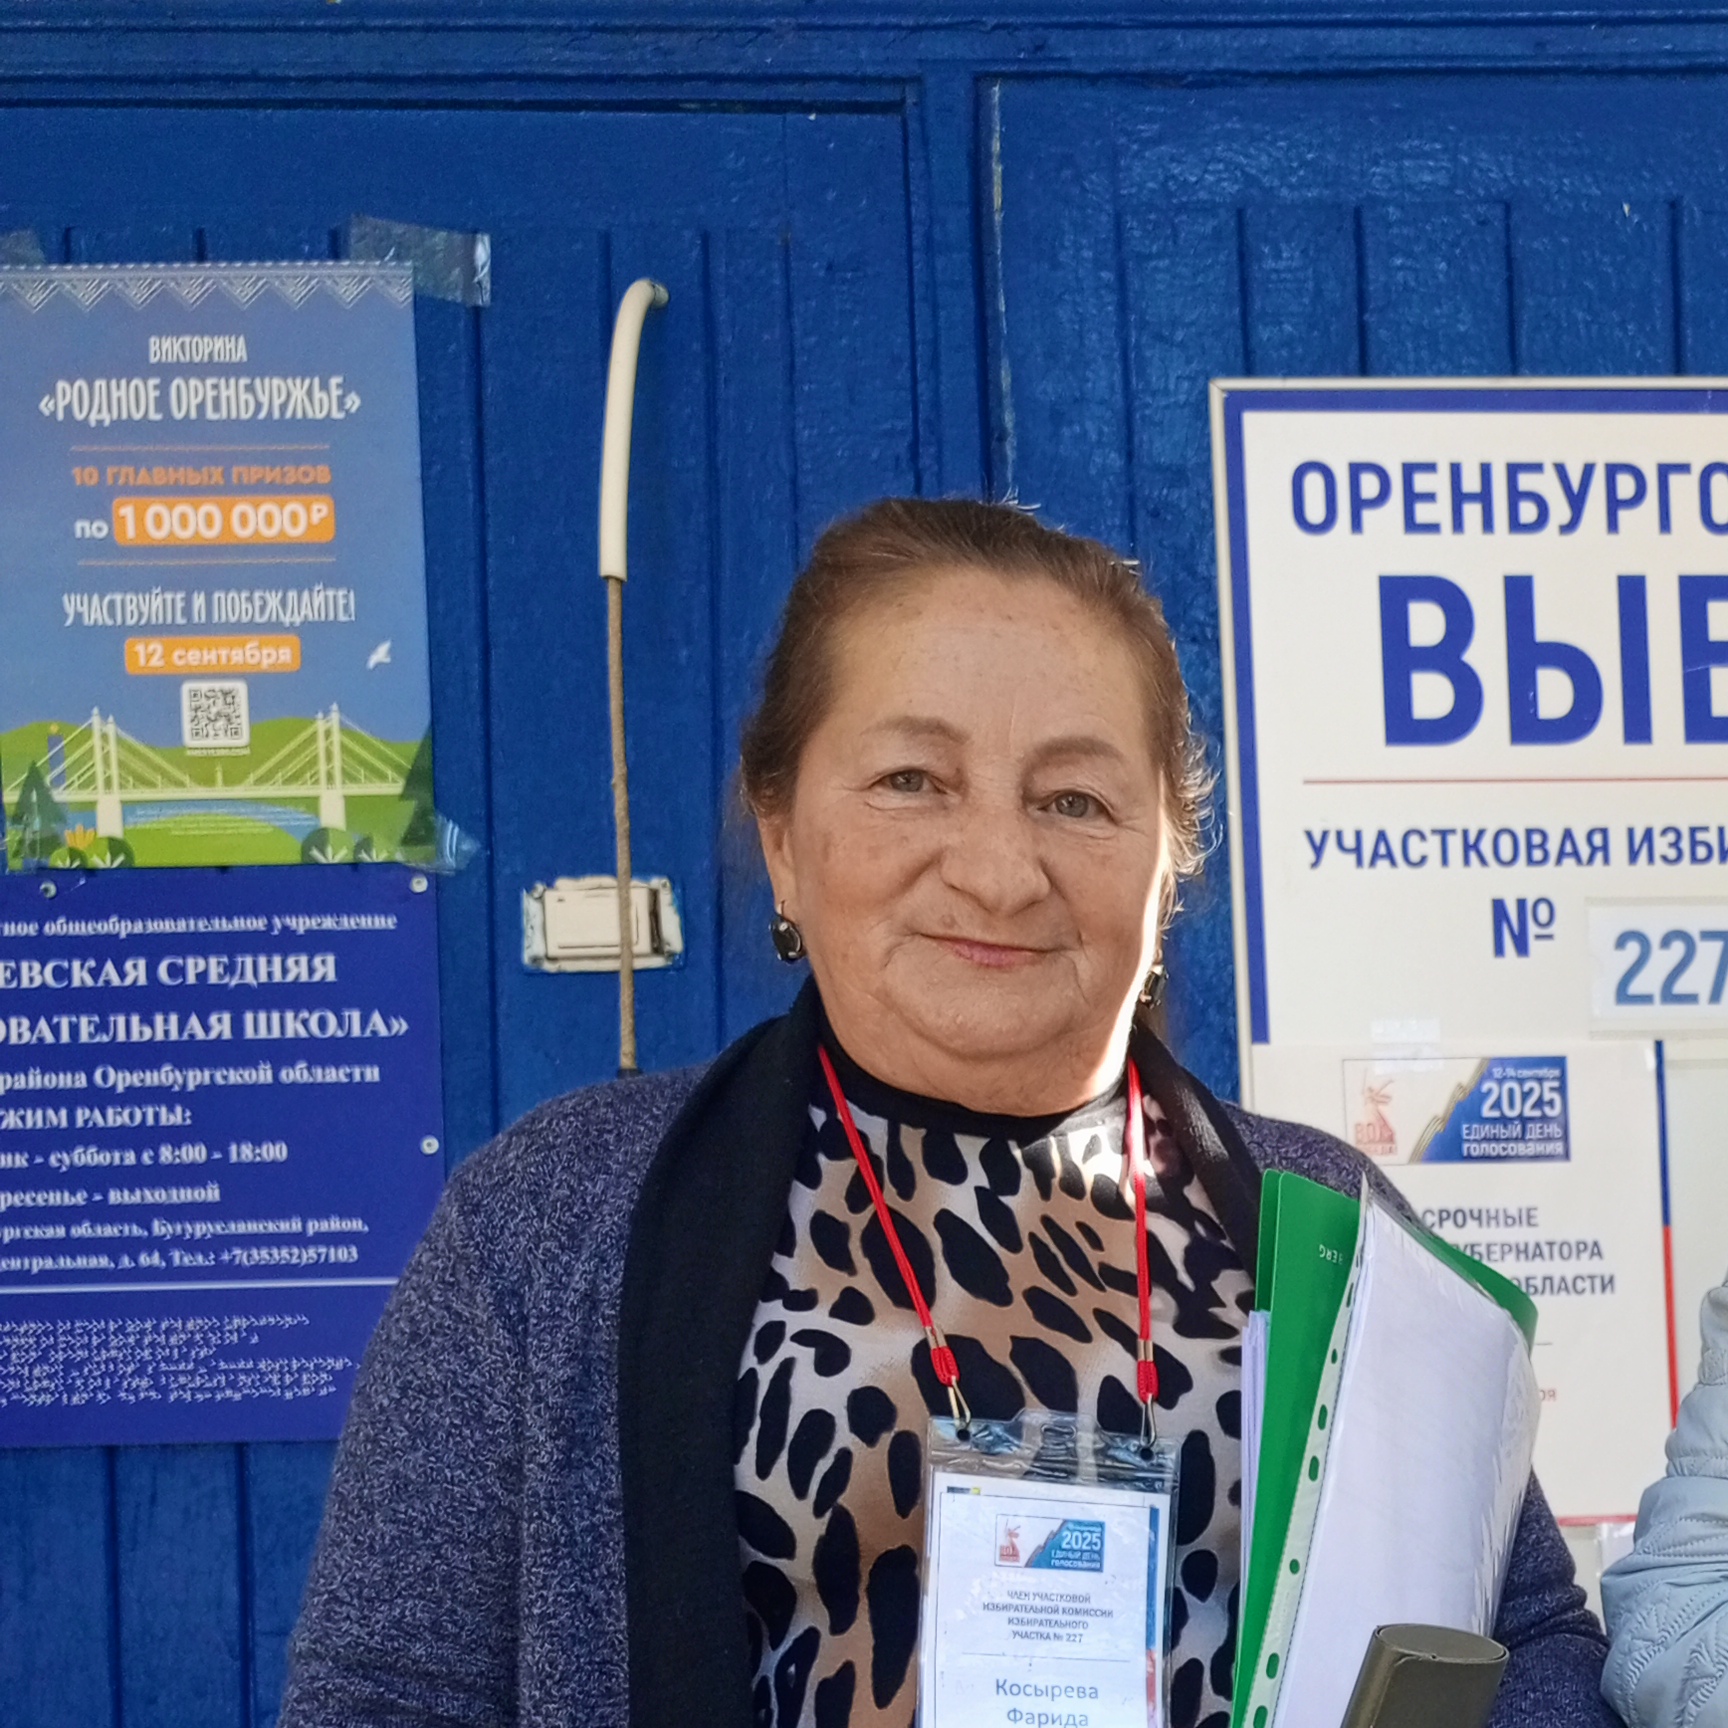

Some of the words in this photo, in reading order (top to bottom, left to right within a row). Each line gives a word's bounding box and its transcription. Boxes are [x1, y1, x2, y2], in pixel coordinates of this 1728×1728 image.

[149, 334, 248, 363] ВИКТОРИНА
[39, 378, 163, 428] «РОДНОЕ
[170, 376, 361, 421] ОРЕНБУРЖЬЕ»
[72, 466, 99, 486] 10
[107, 465, 225, 486] ГЛАВНЫХ
[232, 464, 333, 485] ПРИЗОВ
[74, 519, 109, 539] по
[62, 585, 187, 627] УЧАСТВУЙТЕ
[192, 590, 206, 624] И
[212, 582, 356, 627] ПОБЕЖДАЙТЕ!
[134, 641, 165, 667] 12
[172, 640, 293, 670] сентября
[1303, 827, 1613, 870] УЧАСТКОВАЯ
[0, 920, 38, 937] ное
[43, 913, 268, 940] общеобразовательное
[270, 912, 398, 936] учреждение
[1490, 898, 1556, 959] №
[156, 951, 338, 990] СРЕДНЯЯ
[243, 1006, 410, 1040] ШКОЛА»
[0, 1066, 88, 1096] района
[93, 1059, 274, 1094] Оренбургской
[278, 1058, 381, 1085] области
[1480, 1080, 1563, 1118] 2025
[75, 1103, 192, 1128] РАБОТЫ:
[1462, 1120, 1522, 1141] ЕДИНЫЙ
[1525, 1122, 1563, 1141] ДЕНЬ
[48, 1144, 137, 1173] суббота
[140, 1149, 155, 1165] с
[158, 1141, 208, 1165] 8:00
[228, 1140, 289, 1164] 18:00
[1462, 1141, 1565, 1158] голосования
[108, 1179, 221, 1206] выходной
[0, 1223, 67, 1245] ргская
[69, 1219, 149, 1239] область,
[152, 1214, 303, 1241] Бугурусланский
[305, 1213, 369, 1238] район,
[1421, 1206, 1540, 1230] СРОЧНЫЕ
[1061, 1530, 1102, 1551] 2025
[982, 1602, 1060, 1616] ИЗБИРАТЕЛЬНОЙ
[1062, 1606, 1114, 1618] КОМИССИИ
[1032, 1591, 1091, 1604] УЧАСТКОВОЙ
[1007, 1617, 1089, 1630] ИЗБИРАТЕЛЬНОГО
[1012, 1630, 1052, 1641] УЧАСТКА
[1065, 1633, 1083, 1643] 227
[995, 1678, 1099, 1701] Косырева
